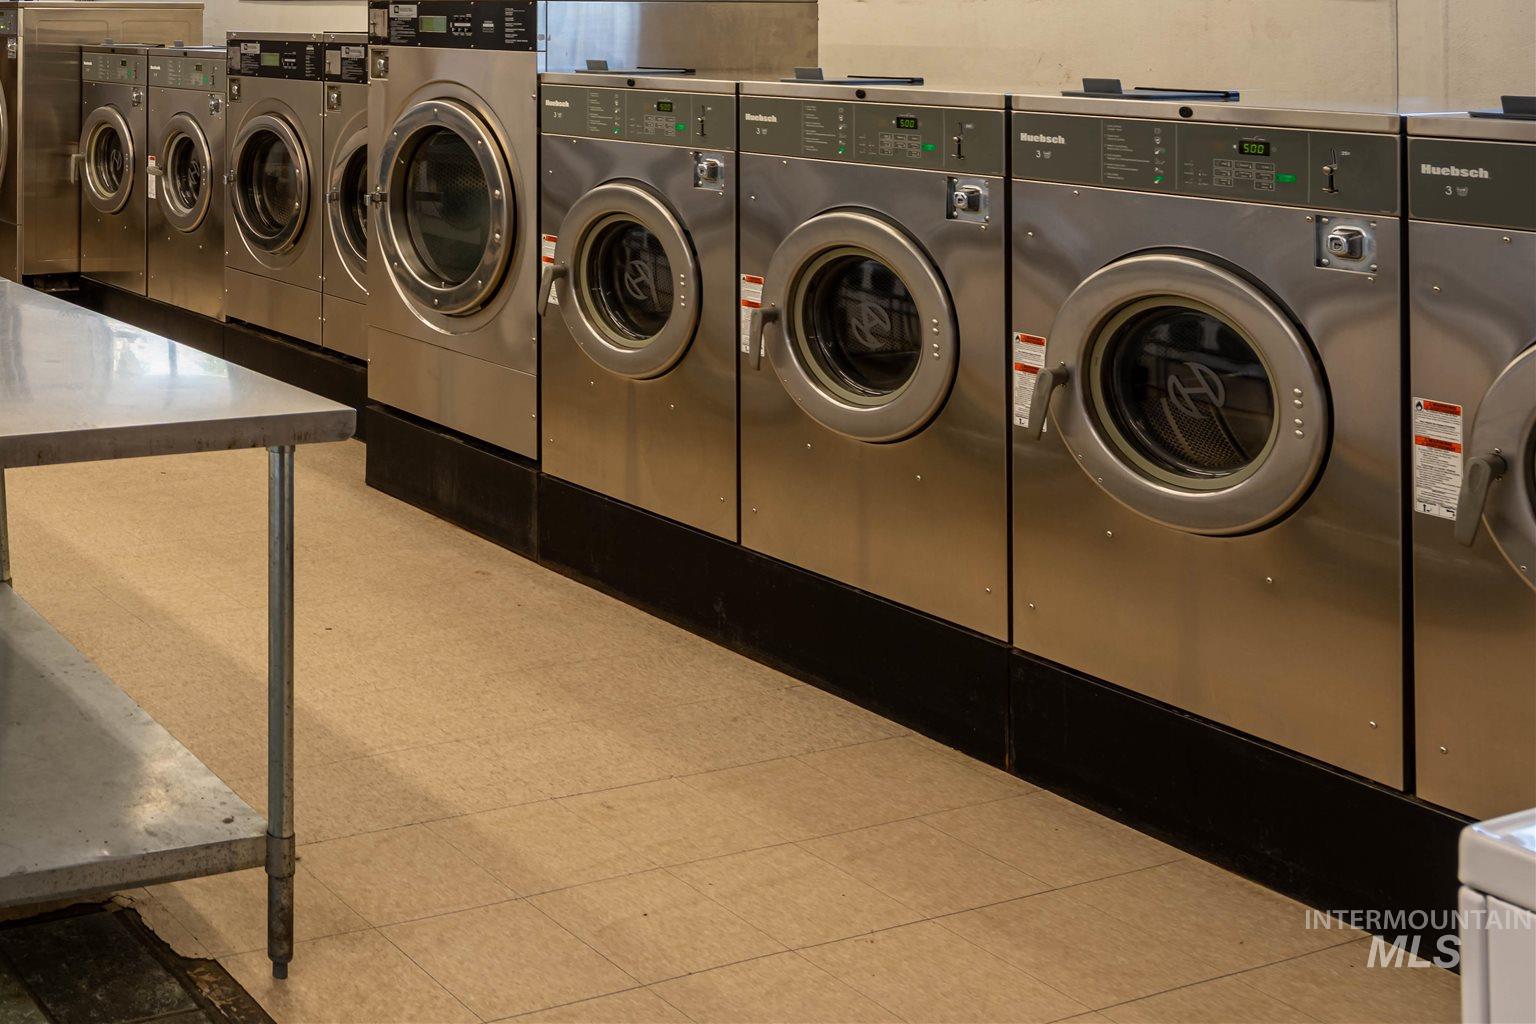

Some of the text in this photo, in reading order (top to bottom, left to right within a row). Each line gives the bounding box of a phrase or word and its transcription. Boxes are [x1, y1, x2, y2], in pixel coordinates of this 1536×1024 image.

[1020, 132, 1066, 145] Huebsch
[1035, 150, 1041, 158] 3
[1243, 143, 1264, 154] 500
[1421, 163, 1490, 179] Huebsch
[1444, 185, 1453, 196] 3
